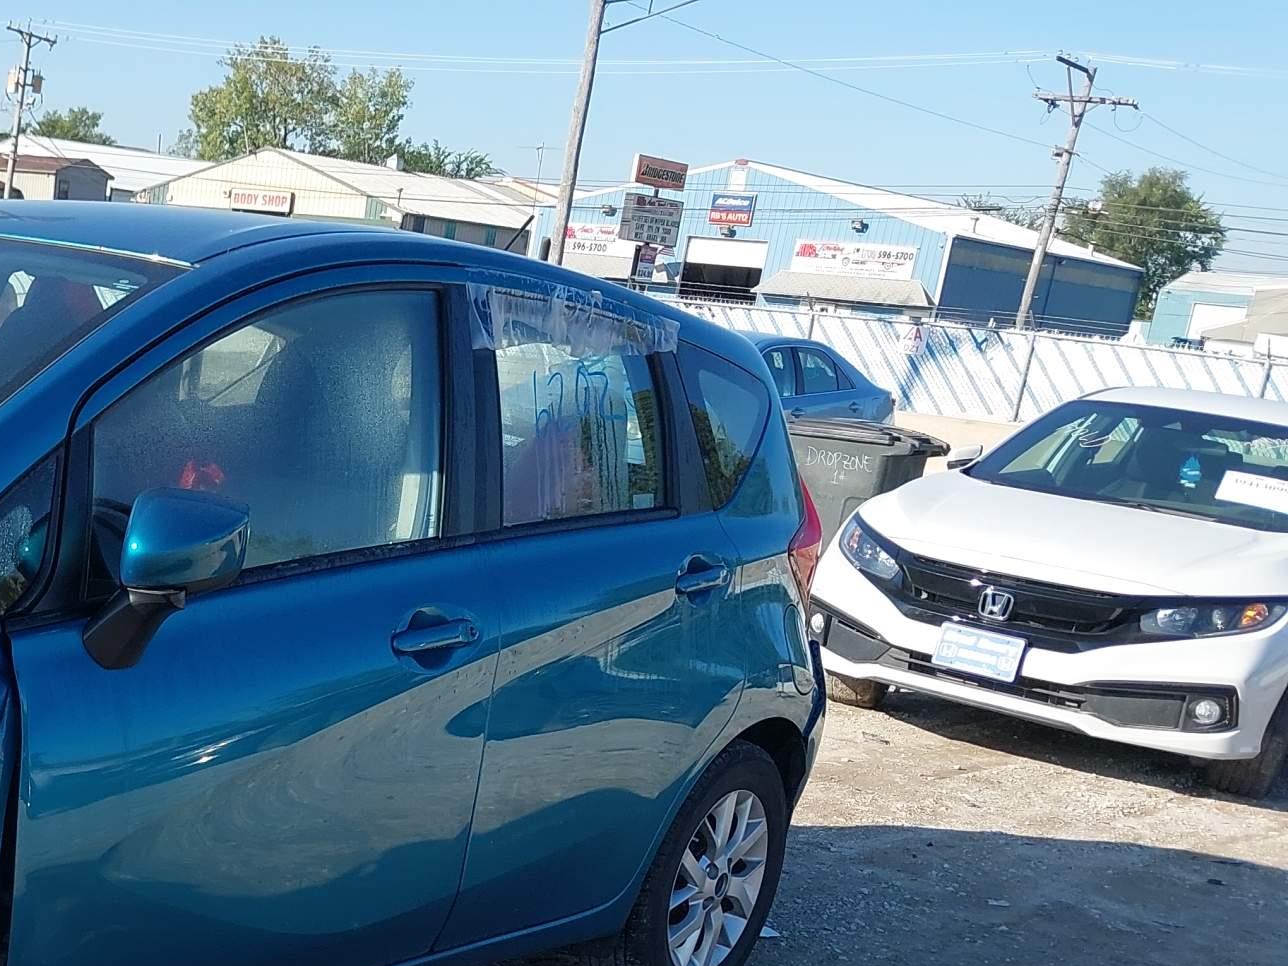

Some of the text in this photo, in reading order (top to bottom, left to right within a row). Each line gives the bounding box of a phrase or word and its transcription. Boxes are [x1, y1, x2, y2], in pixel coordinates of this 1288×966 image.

[640, 163, 685, 184] BRIDGESTONE
[233, 192, 288, 208] BODY SHOP
[727, 213, 749, 221] AUTO
